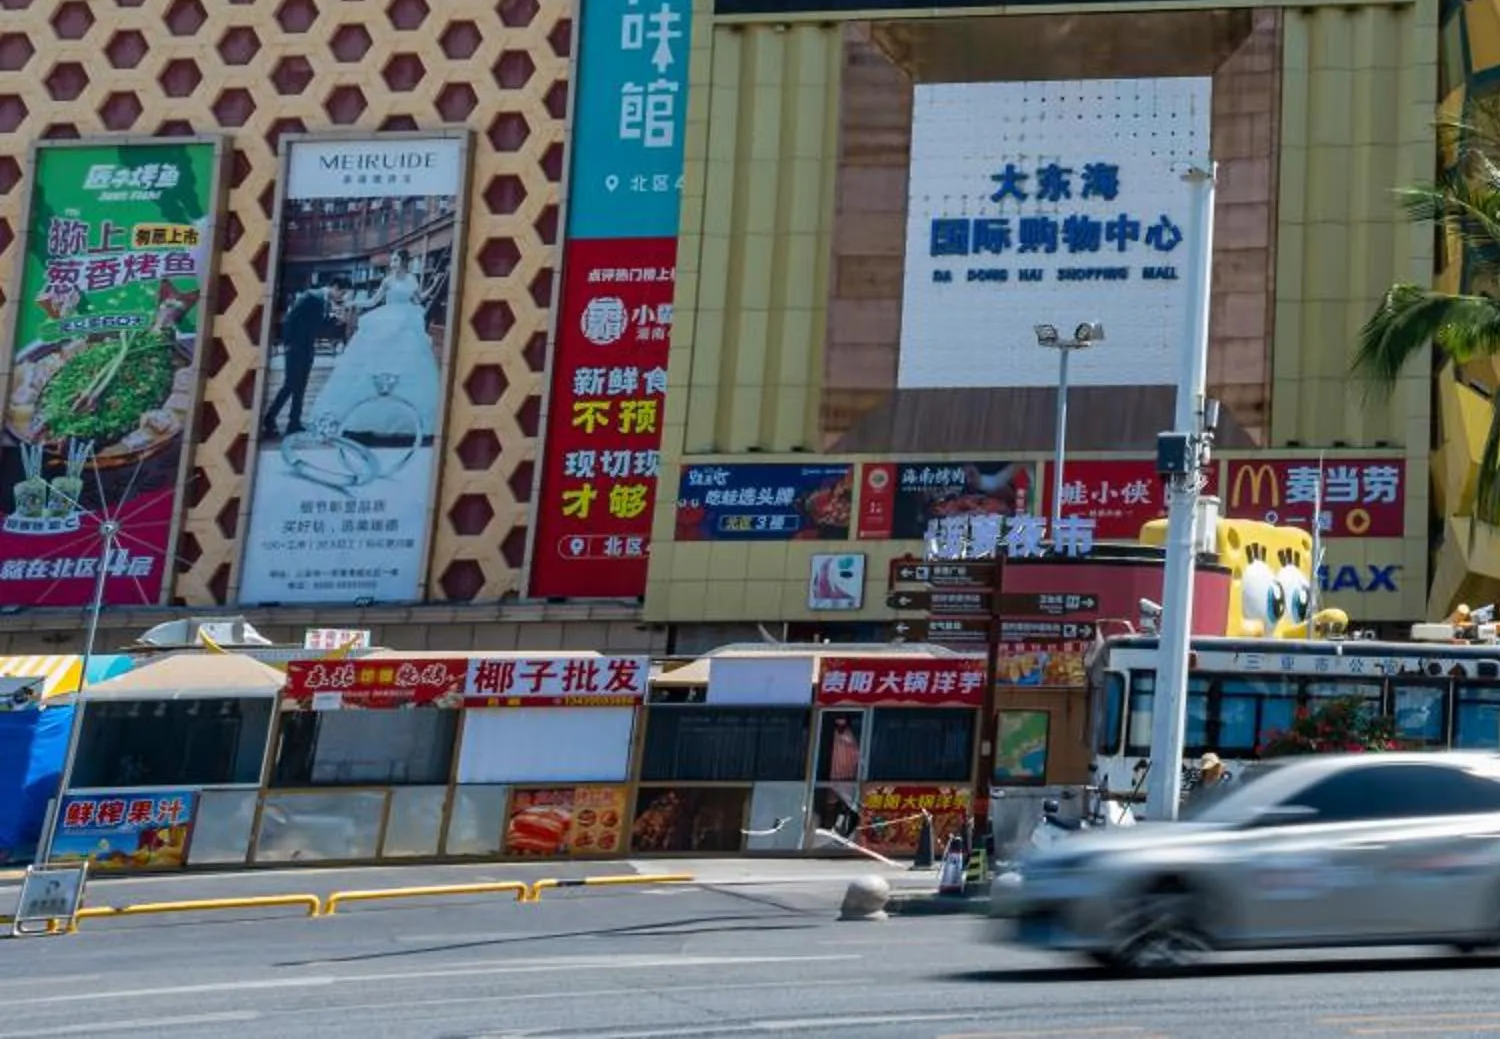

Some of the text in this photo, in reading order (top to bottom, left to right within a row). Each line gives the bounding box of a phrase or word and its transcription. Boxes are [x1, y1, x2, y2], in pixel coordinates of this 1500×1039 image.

[319, 152, 438, 170] MEIRUIDE
[991, 163, 1120, 202] 大东海
[930, 212, 1183, 257] 国际购物中心
[46, 252, 197, 294] 葱香烤鱼
[932, 267, 1180, 282] DA DONG HAI SHOPPING MALL
[1285, 465, 1399, 504] 麦当劳
[473, 659, 641, 693] 椰子批发
[821, 670, 984, 695] 贵阳大锅洋芋
[64, 797, 185, 829] 鲜榨果汁
